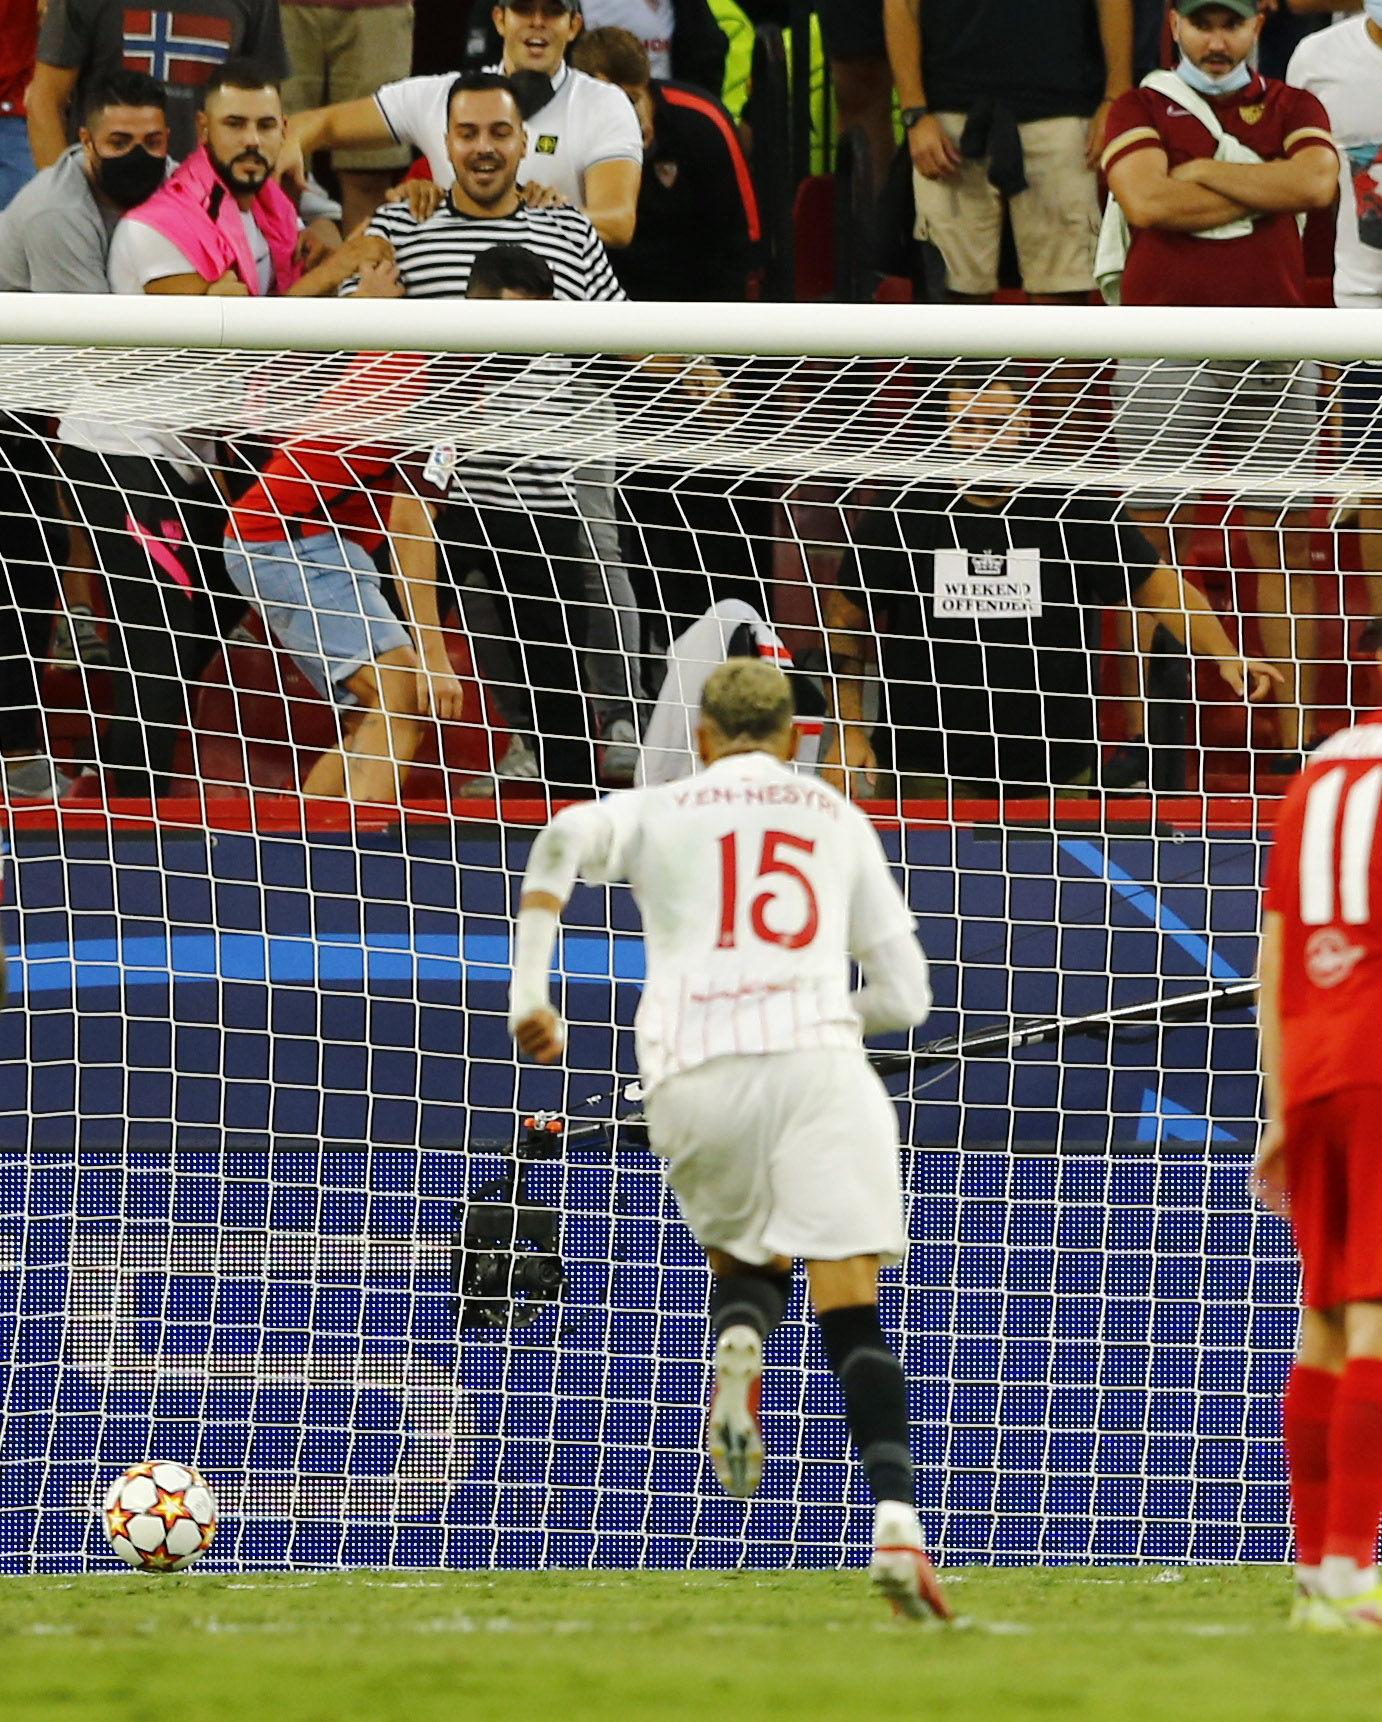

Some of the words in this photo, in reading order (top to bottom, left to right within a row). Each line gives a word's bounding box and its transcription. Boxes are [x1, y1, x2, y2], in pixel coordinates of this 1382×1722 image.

[944, 582, 1031, 596] WEEKEND
[942, 599, 1033, 612] OFFENDER
[715, 829, 819, 949] 15
